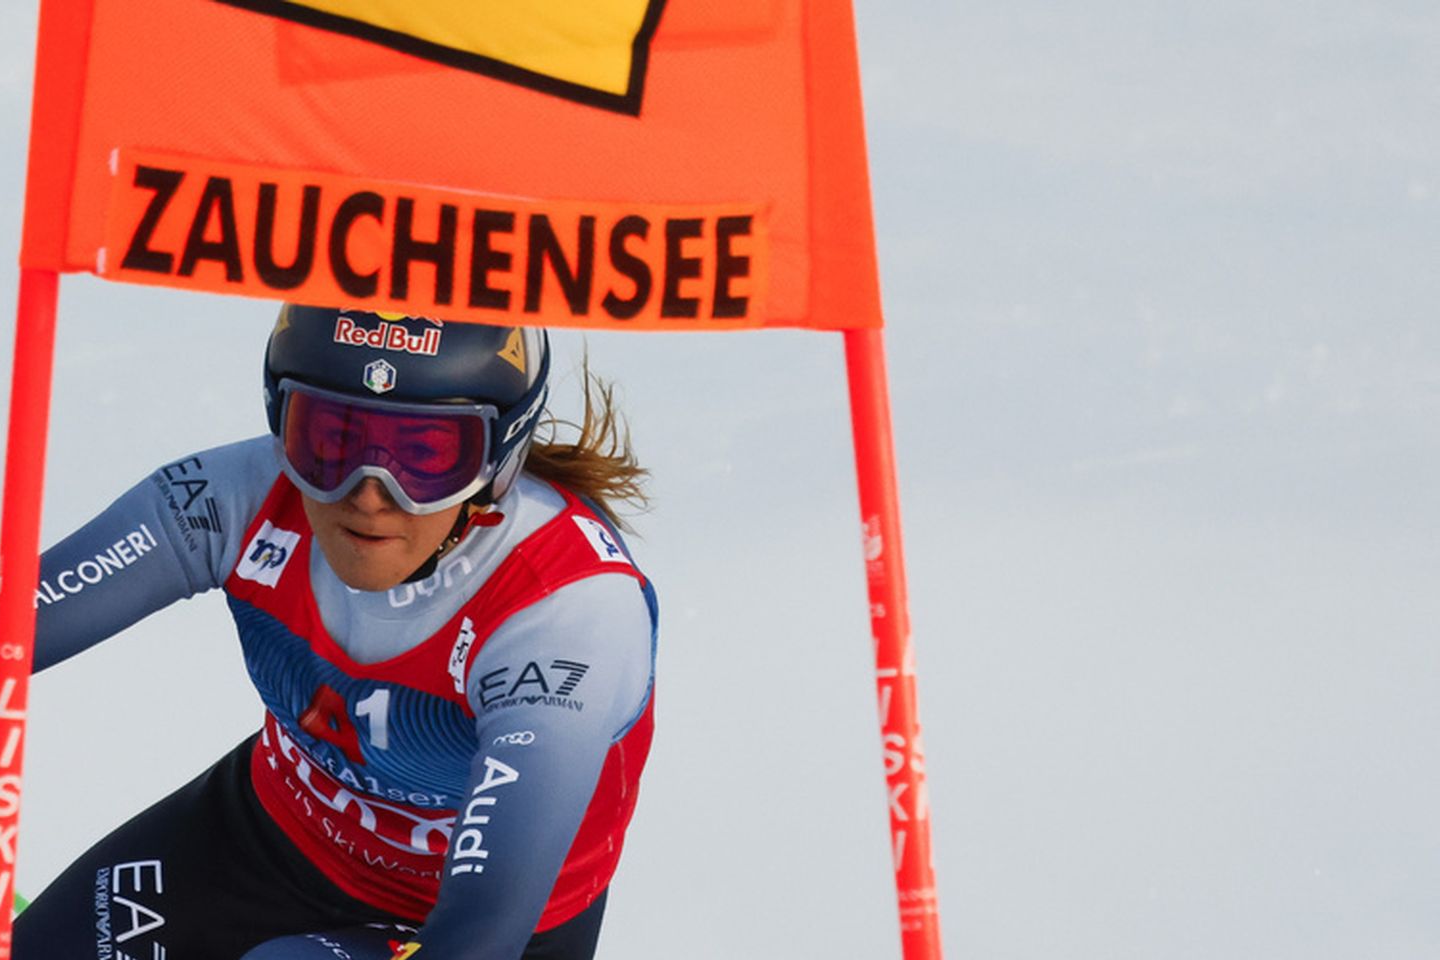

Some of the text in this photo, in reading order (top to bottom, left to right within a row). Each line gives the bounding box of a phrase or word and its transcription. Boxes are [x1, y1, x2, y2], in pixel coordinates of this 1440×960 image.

[121, 164, 755, 321] ZAUCHENSEE
[334, 317, 442, 356] Red Bull
[33, 523, 158, 610] ALCONERI
[479, 659, 591, 710] EA7
[450, 755, 520, 876] Audi
